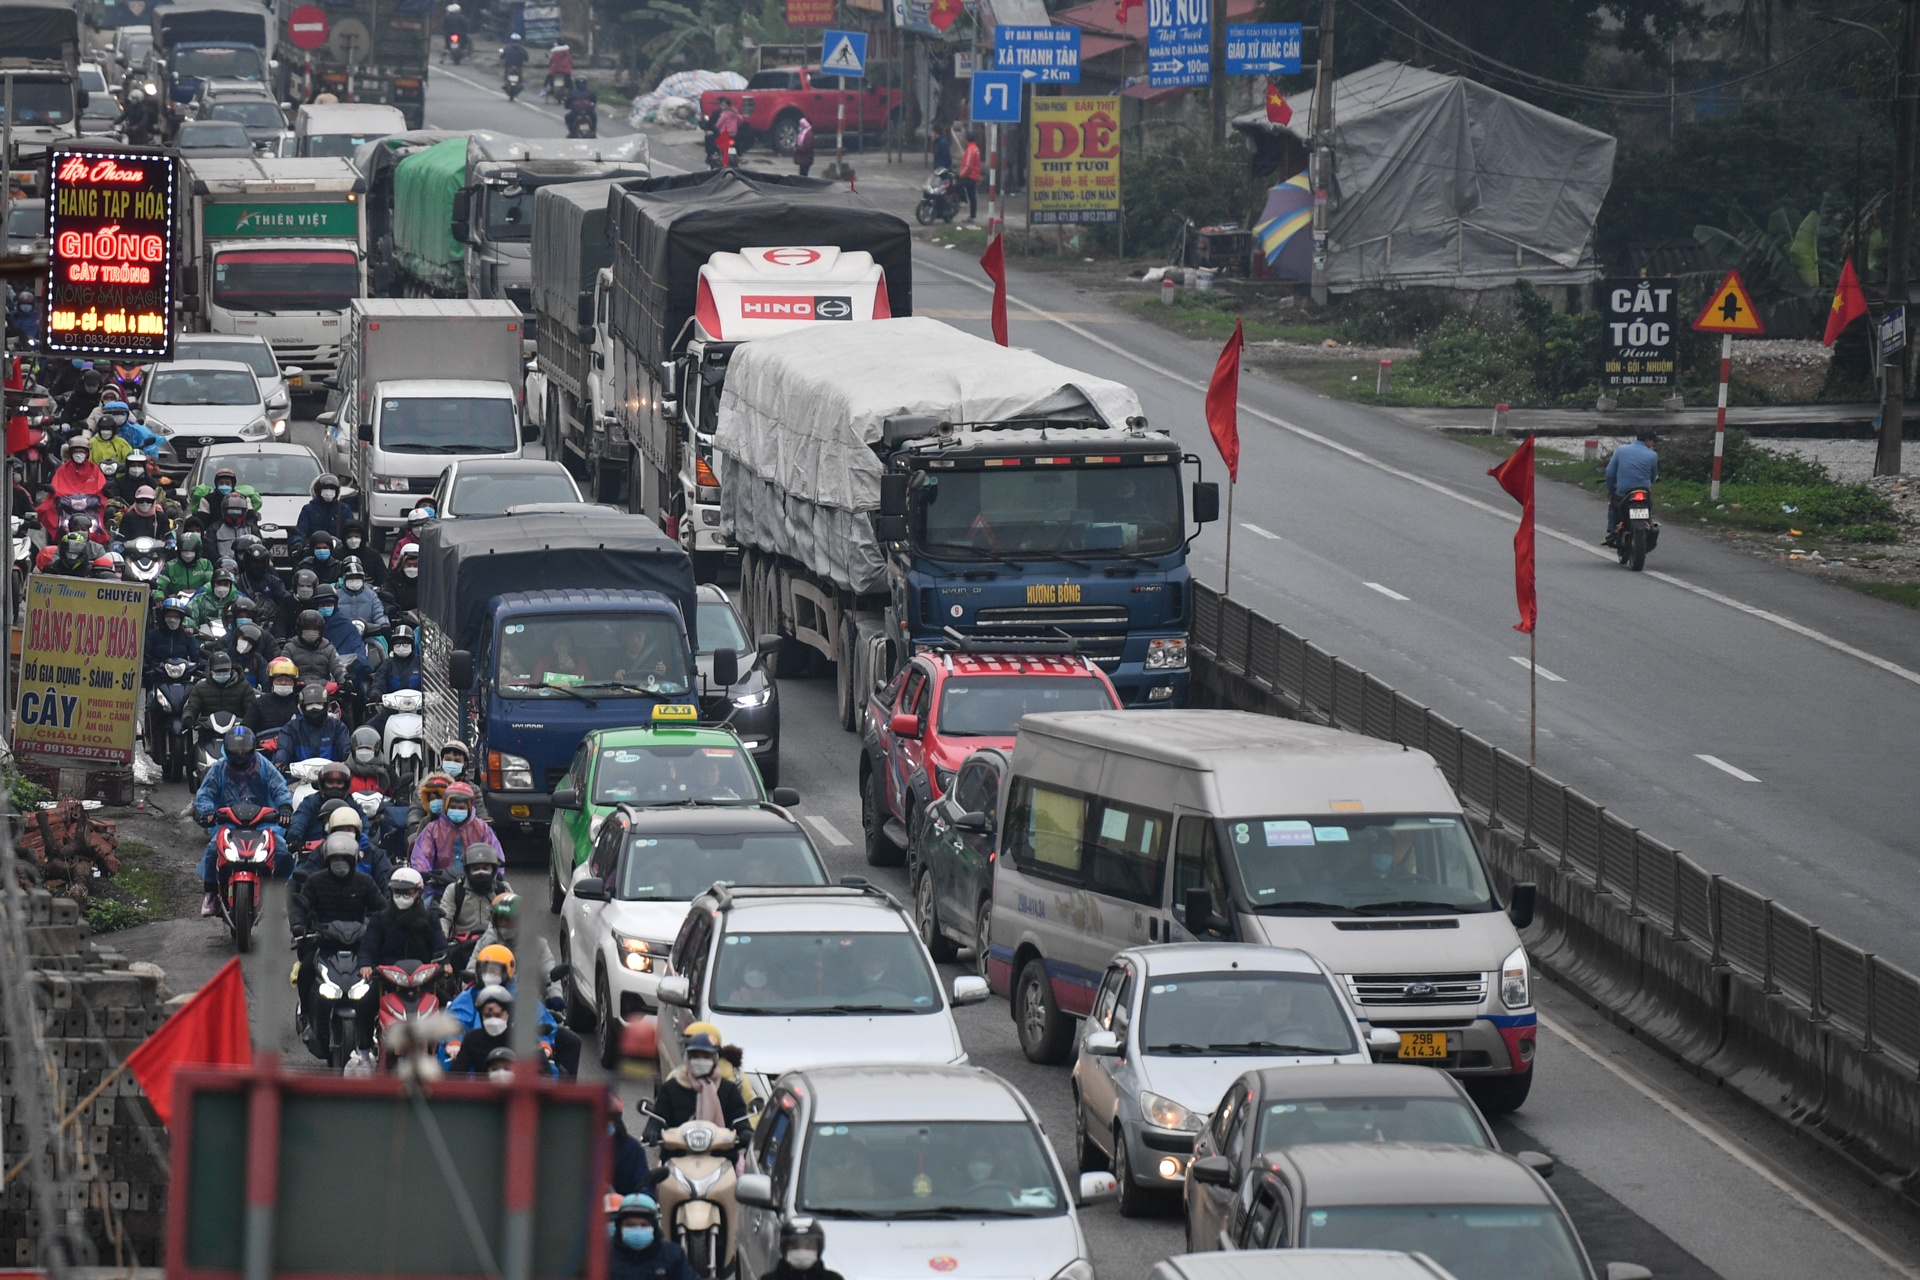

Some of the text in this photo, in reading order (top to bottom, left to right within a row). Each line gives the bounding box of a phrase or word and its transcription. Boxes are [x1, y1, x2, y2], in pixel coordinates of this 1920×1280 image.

[1016, 30, 1031, 40] BAN
[998, 44, 1014, 65] XÃ
[1016, 48, 1053, 65] THANH
[1056, 44, 1077, 65] TÂN
[1227, 39, 1246, 59] GIÁO
[1187, 59, 1209, 73] 100m
[1034, 111, 1119, 159] DÊ
[59, 157, 144, 182] Hội Thoan
[1041, 161, 1072, 173] THỊT
[58, 182, 98, 217] HÀNG
[134, 185, 165, 220] HÓA
[254, 213, 327, 227] THIÊN VIỆT
[59, 225, 163, 262] GIỐNG
[69, 261, 99, 281] CÂY
[55, 284, 95, 306] NÔNG
[1611, 281, 1672, 313] CẮT
[744, 302, 811, 314] HINO
[52, 310, 75, 330] RAU
[81, 306, 97, 331] CỦ
[104, 307, 127, 334] QUẢ
[128, 315, 136, 333] 4
[64, 333, 152, 347] ĐT: 08342.01252
[1609, 317, 1670, 346] TÓC
[1619, 347, 1659, 357] Nam
[1605, 358, 1621, 372] UỐN
[1627, 359, 1640, 375] GỘI
[1646, 359, 1673, 375] NHUỘM
[34, 581, 142, 603] Hội Thoan CHUYÊN
[29, 597, 138, 665] HÀNG TẠP HÓA
[39, 664, 54, 683] GIA
[56, 666, 81, 688] DỤNG
[89, 666, 114, 689] SÀNH
[121, 668, 136, 691] SỨ
[20, 686, 79, 728] CÂY
[87, 698, 114, 708] PHONG
[86, 710, 102, 719] HOA
[109, 709, 130, 722] CẢNH
[85, 721, 114, 732] ĂN QUẢ
[82, 734, 113, 744] HOA
[44, 743, 126, 759] 0913.287.164
[1412, 985, 1431, 994] Ford
[1412, 1034, 1434, 1045] 29B
[1403, 1046, 1442, 1057] 414.34
